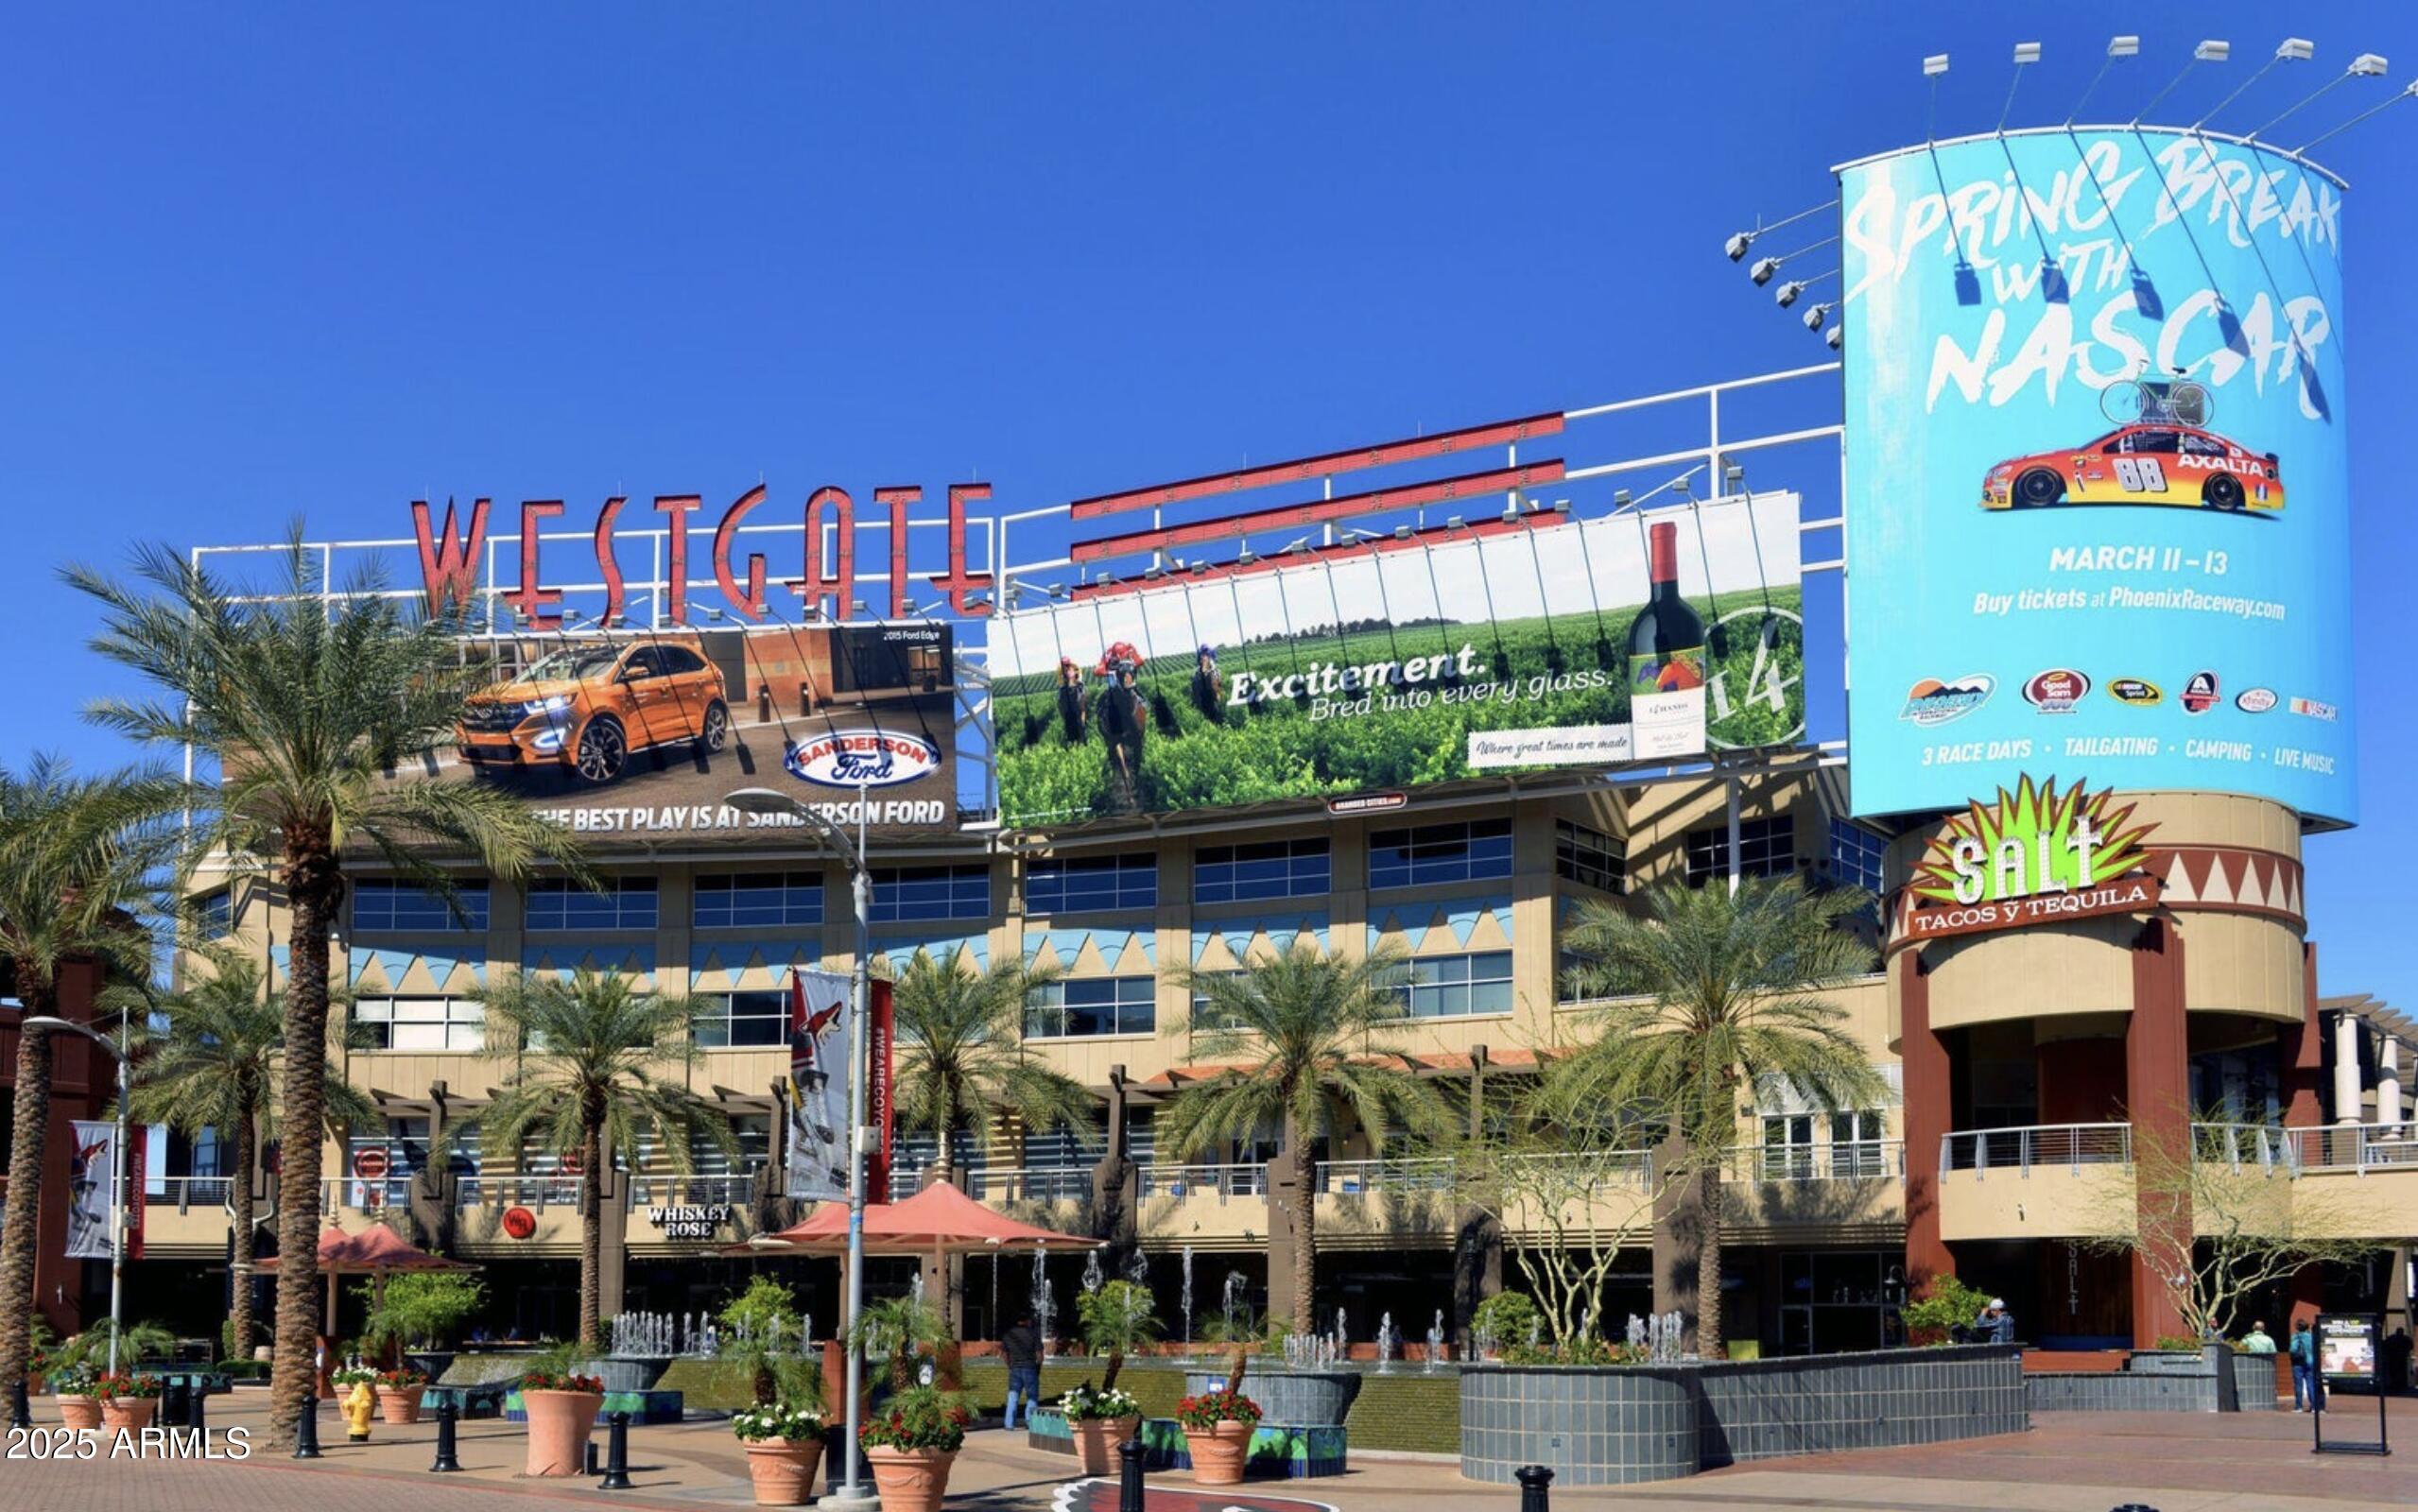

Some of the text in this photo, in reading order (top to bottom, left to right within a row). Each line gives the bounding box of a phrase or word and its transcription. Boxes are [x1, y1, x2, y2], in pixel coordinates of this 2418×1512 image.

[2142, 137, 2341, 254] BREAK
[1926, 289, 2330, 420] NASCAR
[2112, 458, 2168, 492] 88
[2178, 454, 2265, 477] AXALTA
[410, 483, 993, 630] WESTGATE
[2049, 545, 2155, 572] MARCH
[1974, 586, 2286, 621] Buy tickets at PhoenixRaceway.com
[903, 630, 920, 640] Ford
[921, 630, 941, 642] Edge
[1227, 643, 1487, 707] Excitement.
[1704, 617, 1800, 725] 14
[2041, 679, 2072, 690] Good
[1309, 668, 1613, 722] Bred into every glass.
[2047, 688, 2072, 697] Sam
[2306, 701, 2337, 721] NASCAR
[798, 737, 927, 767] SANDERSON
[1476, 736, 1628, 759] Where great times are made
[1922, 739, 2032, 765] 3 RACE DAYS
[2064, 737, 2159, 757] TAILGATING
[2185, 738, 2253, 763] CAMPING
[2274, 747, 2336, 775] LIVE MUSIC
[831, 752, 894, 781] Ford
[575, 808, 630, 832] BEST
[631, 806, 689, 830] PLAY
[690, 805, 713, 829] IS
[884, 799, 945, 824] FORD
[1915, 906, 1997, 932] TACOS
[2026, 885, 2149, 916] TEQUILA
[873, 1026, 886, 1154] #WEARECOYO
[648, 1206, 729, 1222] WHISKEY
[665, 1222, 712, 1237] ROSE
